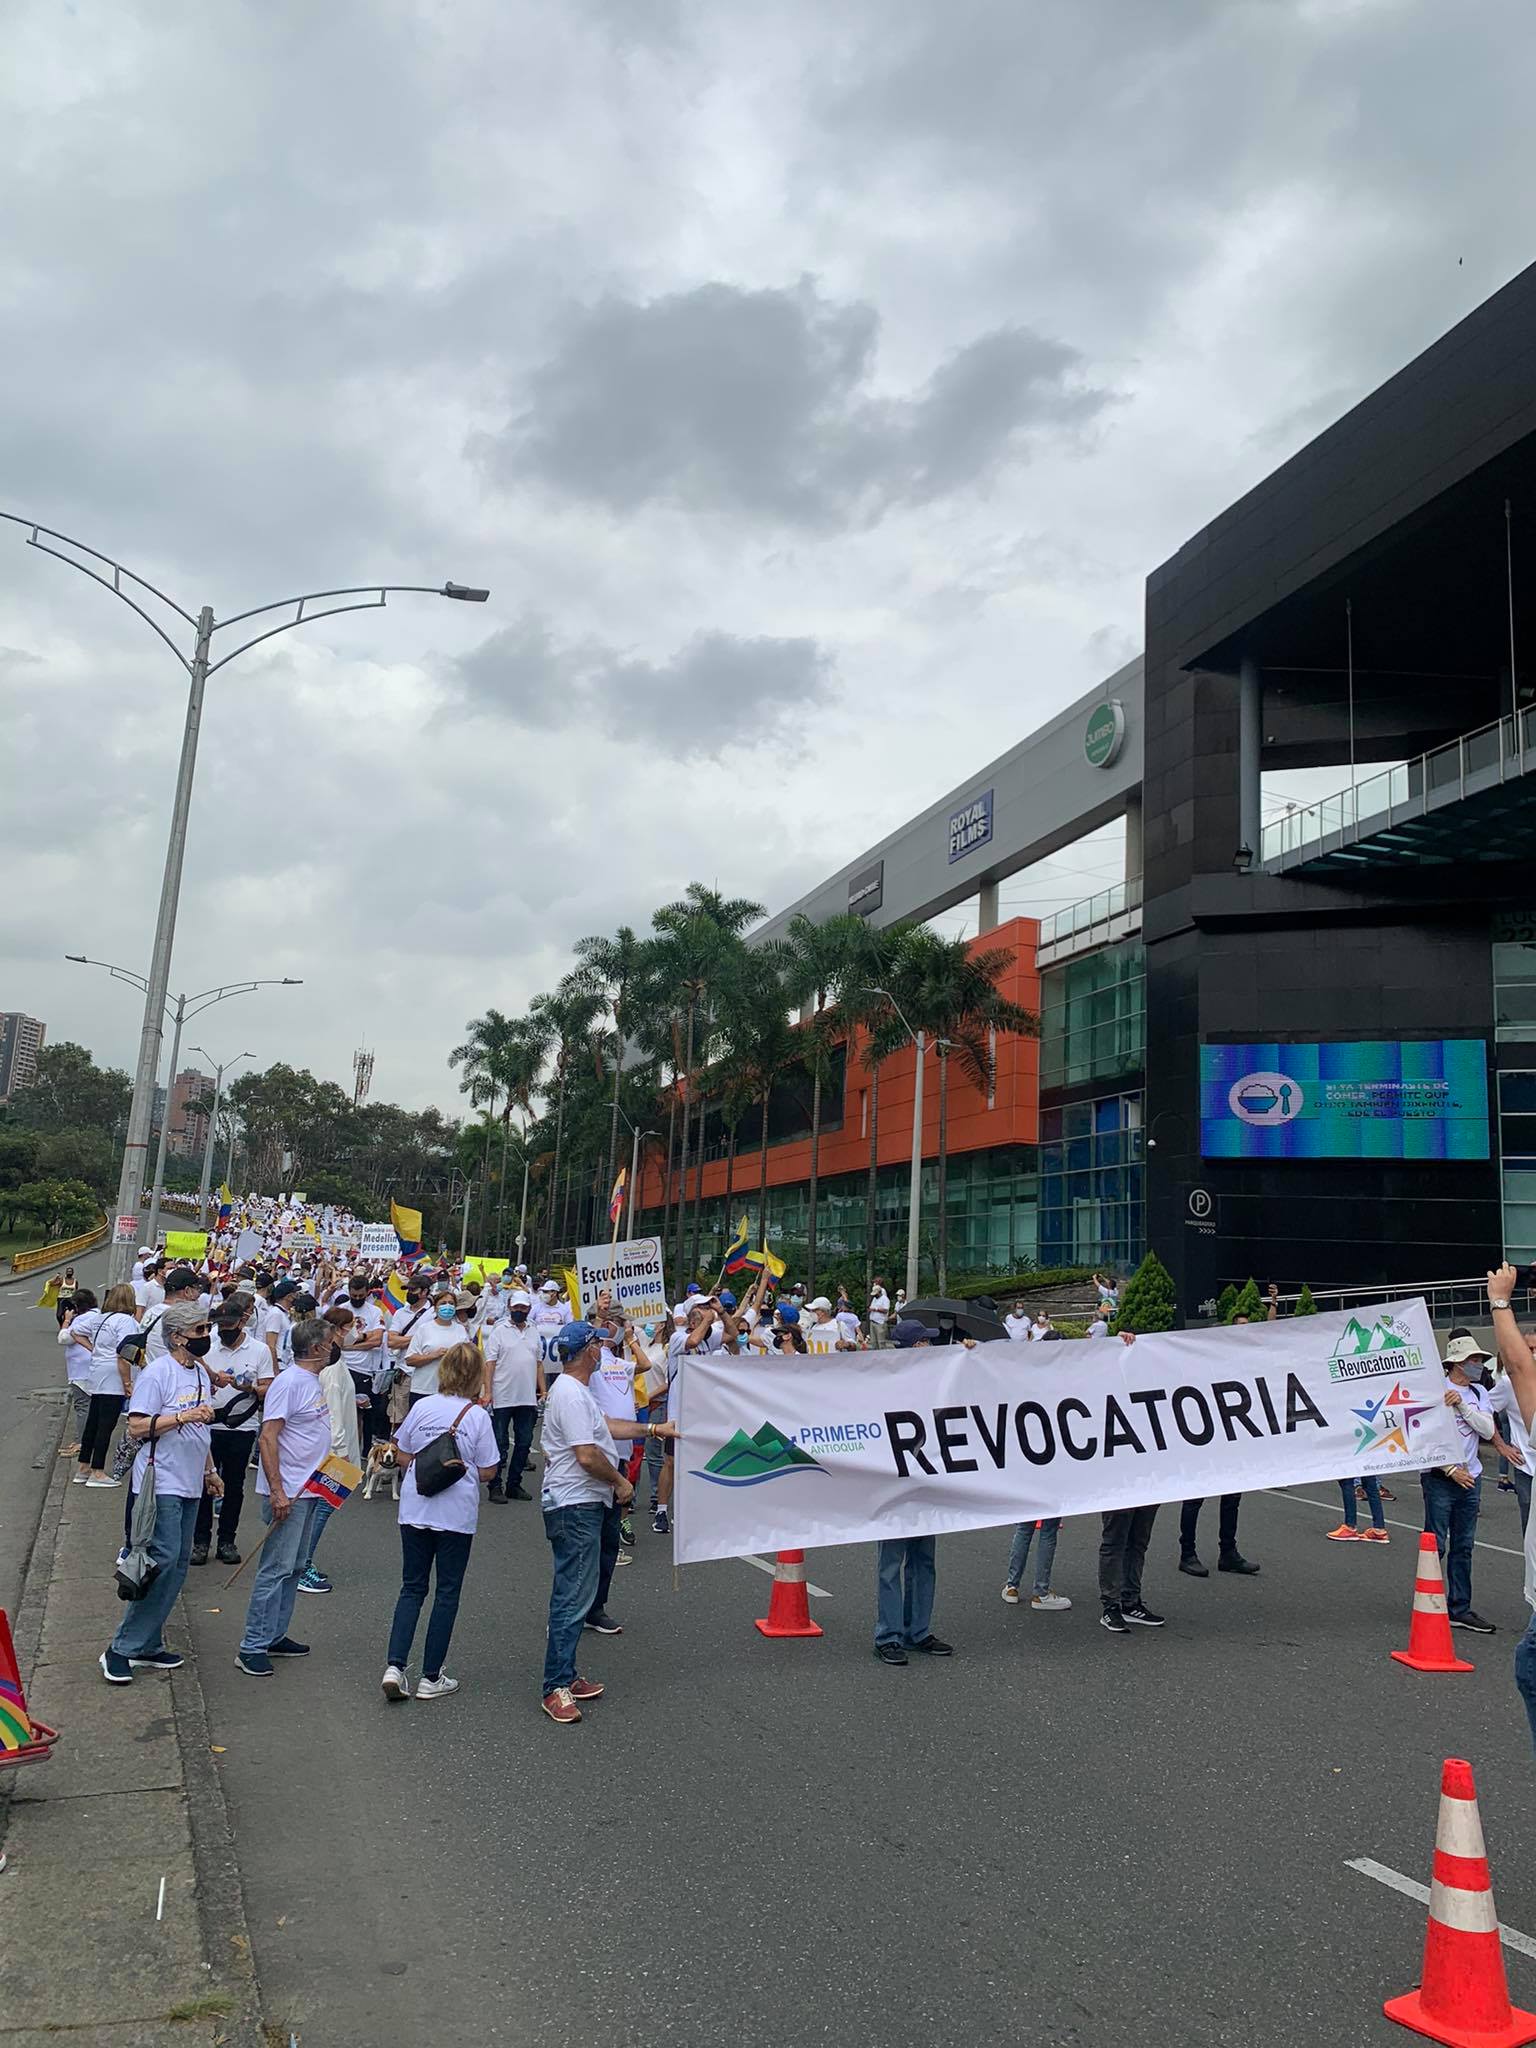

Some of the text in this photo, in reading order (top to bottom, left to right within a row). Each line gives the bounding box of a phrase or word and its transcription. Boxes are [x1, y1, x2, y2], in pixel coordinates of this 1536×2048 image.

[951, 801, 986, 836] ROYAL
[950, 819, 986, 855] FILMS
[362, 1243, 398, 1254] presente
[582, 1261, 660, 1284] Escuchamos
[582, 1292, 590, 1304] a
[616, 1281, 662, 1301] jovenes
[1328, 1360, 1341, 1379] PRO
[1337, 1347, 1424, 1378] Revocatoria Ya!
[884, 1372, 1329, 1478] REVOCATORIA
[1381, 1410, 1398, 1429] R
[800, 1423, 882, 1443] PRIMERO
[810, 1442, 866, 1455] ANTIOQUIA
